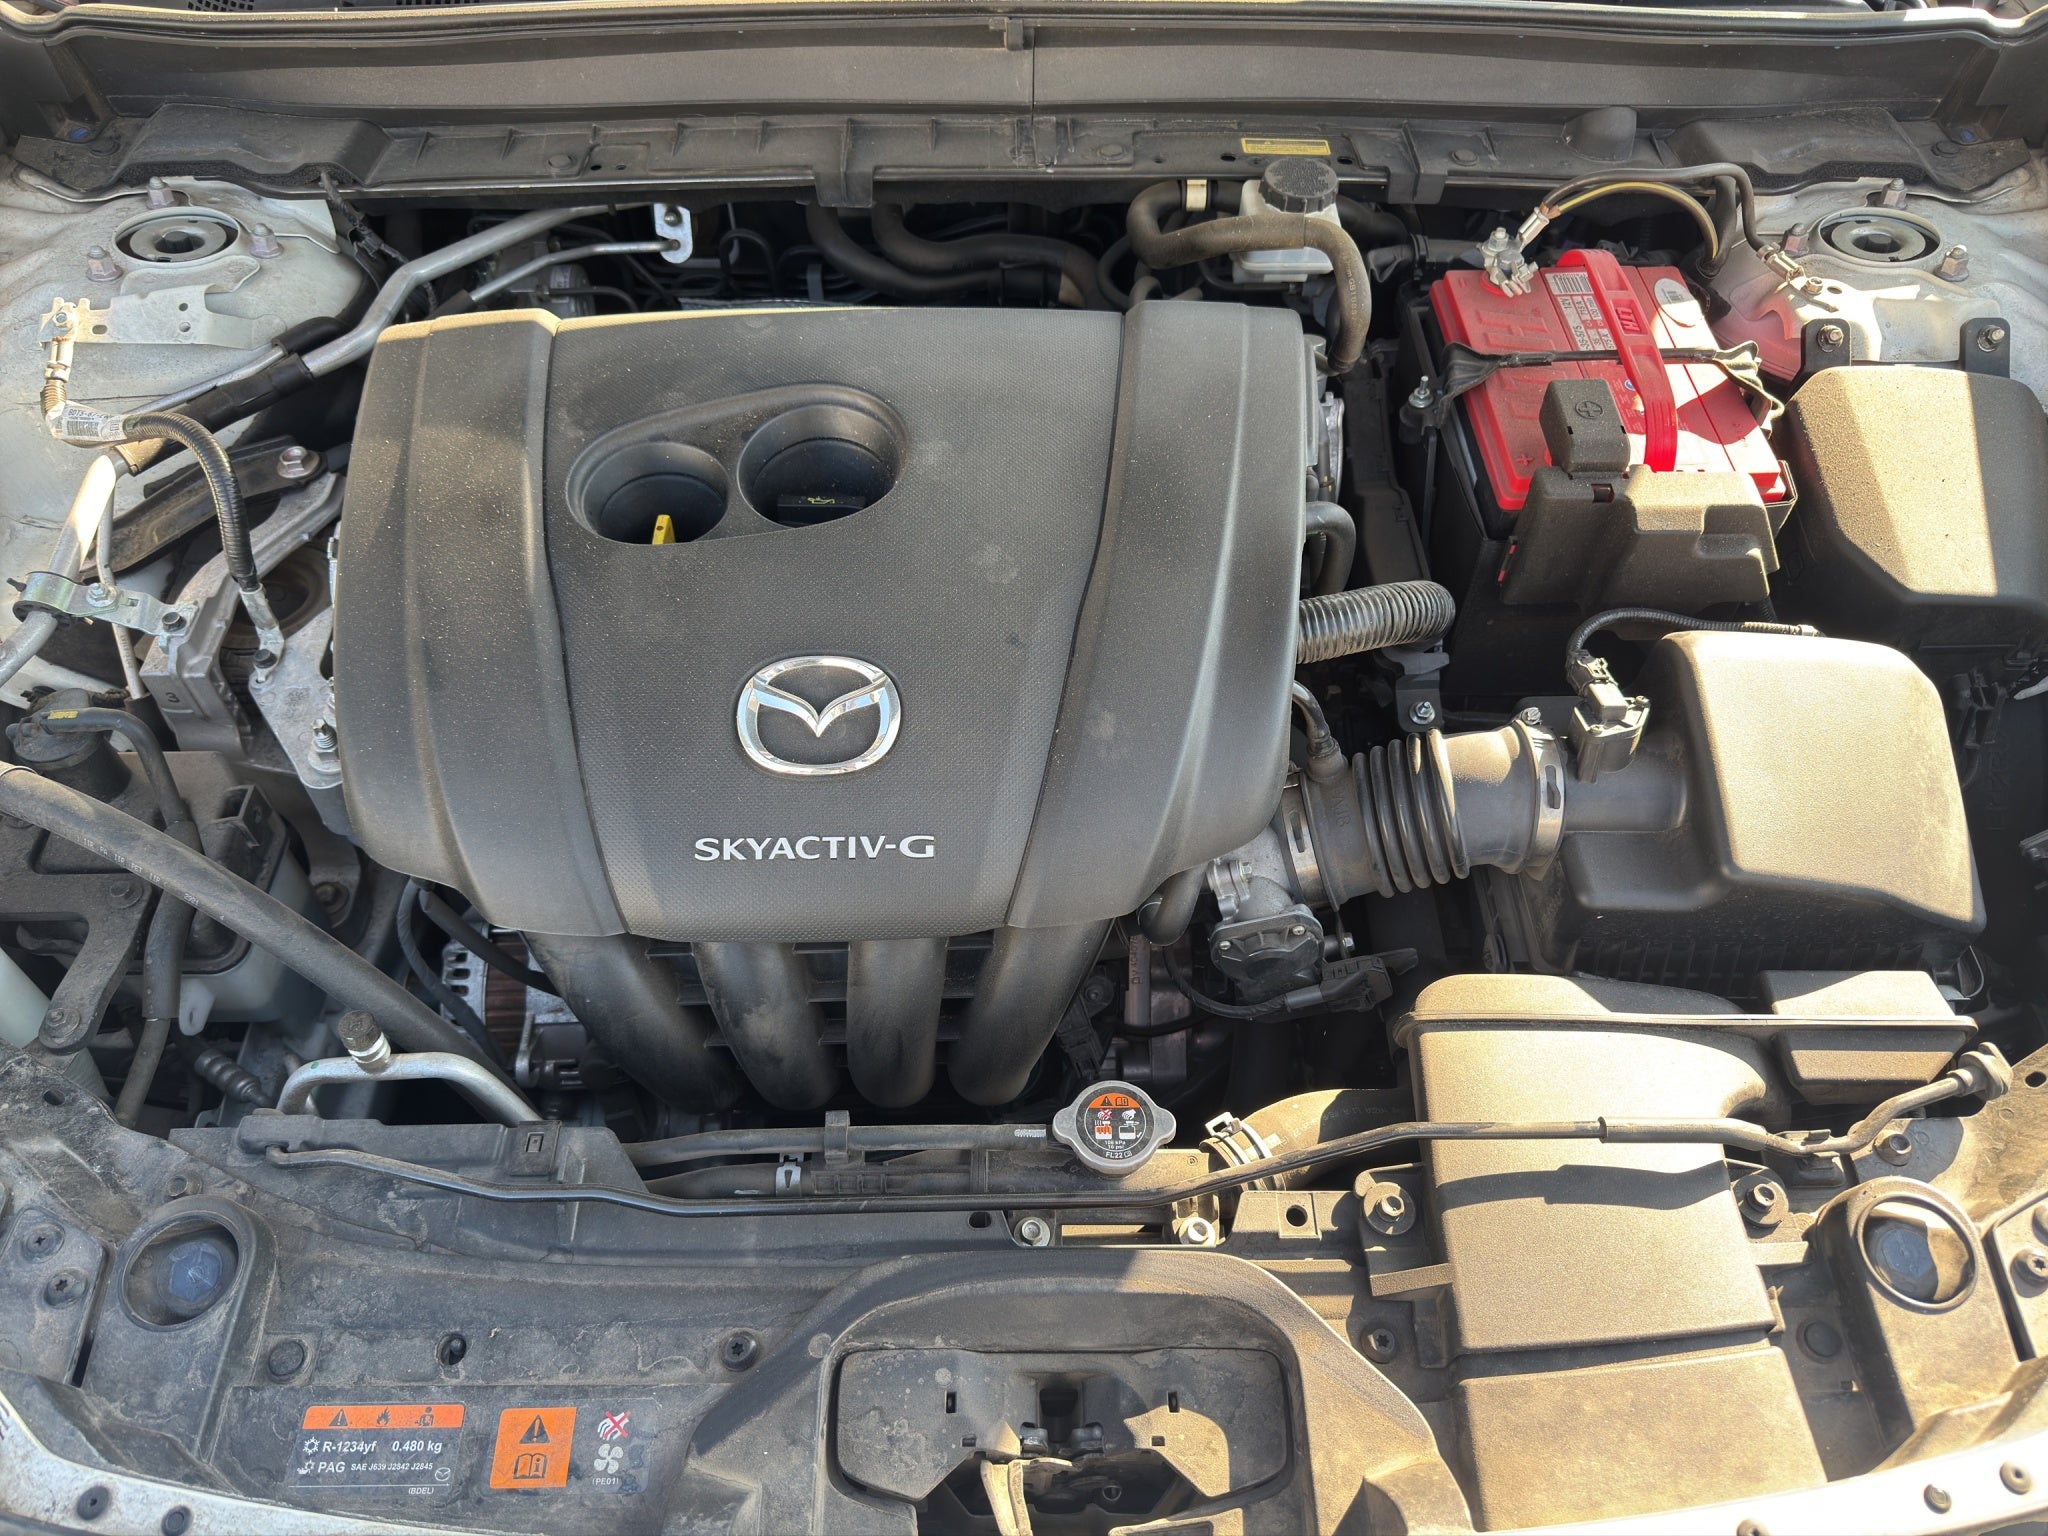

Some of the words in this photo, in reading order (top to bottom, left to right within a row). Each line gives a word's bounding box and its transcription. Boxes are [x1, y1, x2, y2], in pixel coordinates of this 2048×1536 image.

[1615, 307, 1642, 333] LTH
[165, 692, 181, 703] 3
[694, 835, 935, 861] SKYACTIV-G
[1105, 1151, 1123, 1159] FL22
[322, 1440, 377, 1454] R-1234yf
[392, 1440, 424, 1452] 0.480
[427, 1440, 443, 1454] kg
[317, 1462, 346, 1473] PAG
[350, 1463, 368, 1471] SAE
[411, 1462, 434, 1470] J2845
[592, 1477, 619, 1486] (PE01)
[408, 1487, 434, 1495] (BDEL)
